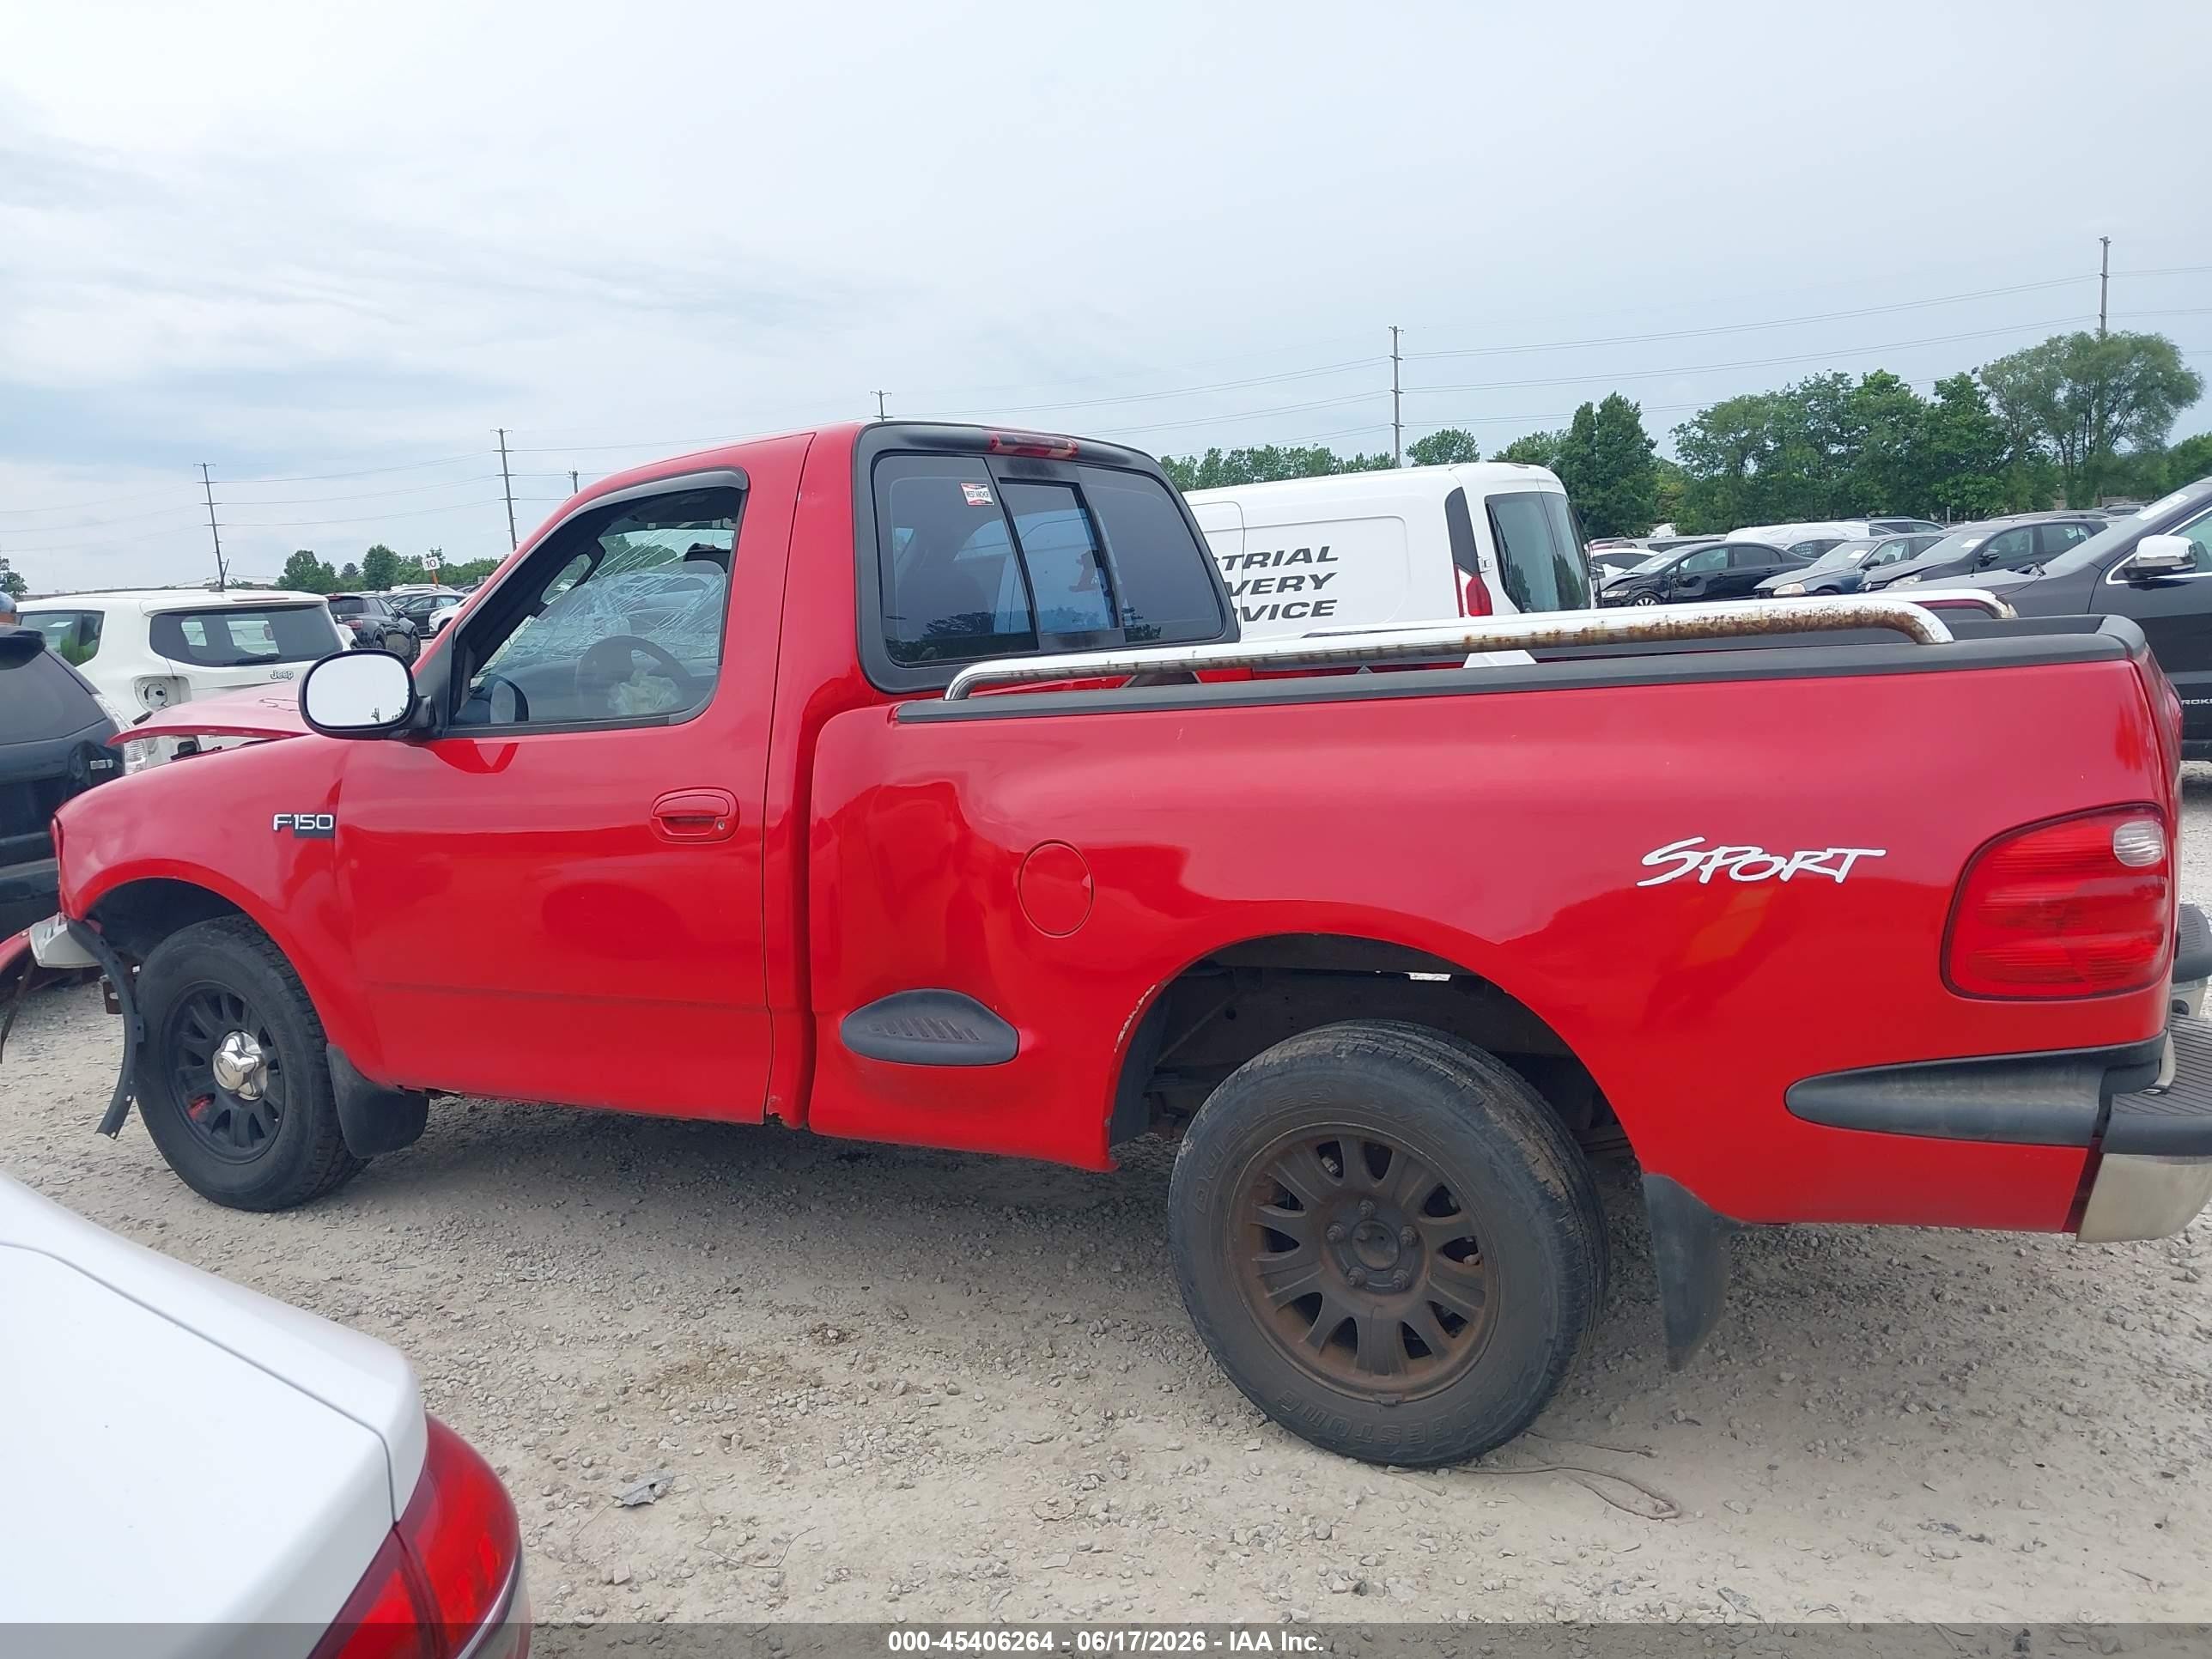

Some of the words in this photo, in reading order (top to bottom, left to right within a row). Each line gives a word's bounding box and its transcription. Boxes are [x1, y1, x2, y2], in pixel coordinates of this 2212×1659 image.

[424, 559, 437, 568] 10
[1212, 546, 1339, 571] TRIAL
[270, 670, 294, 680] Jeep
[1636, 836, 1887, 886] SPORT
